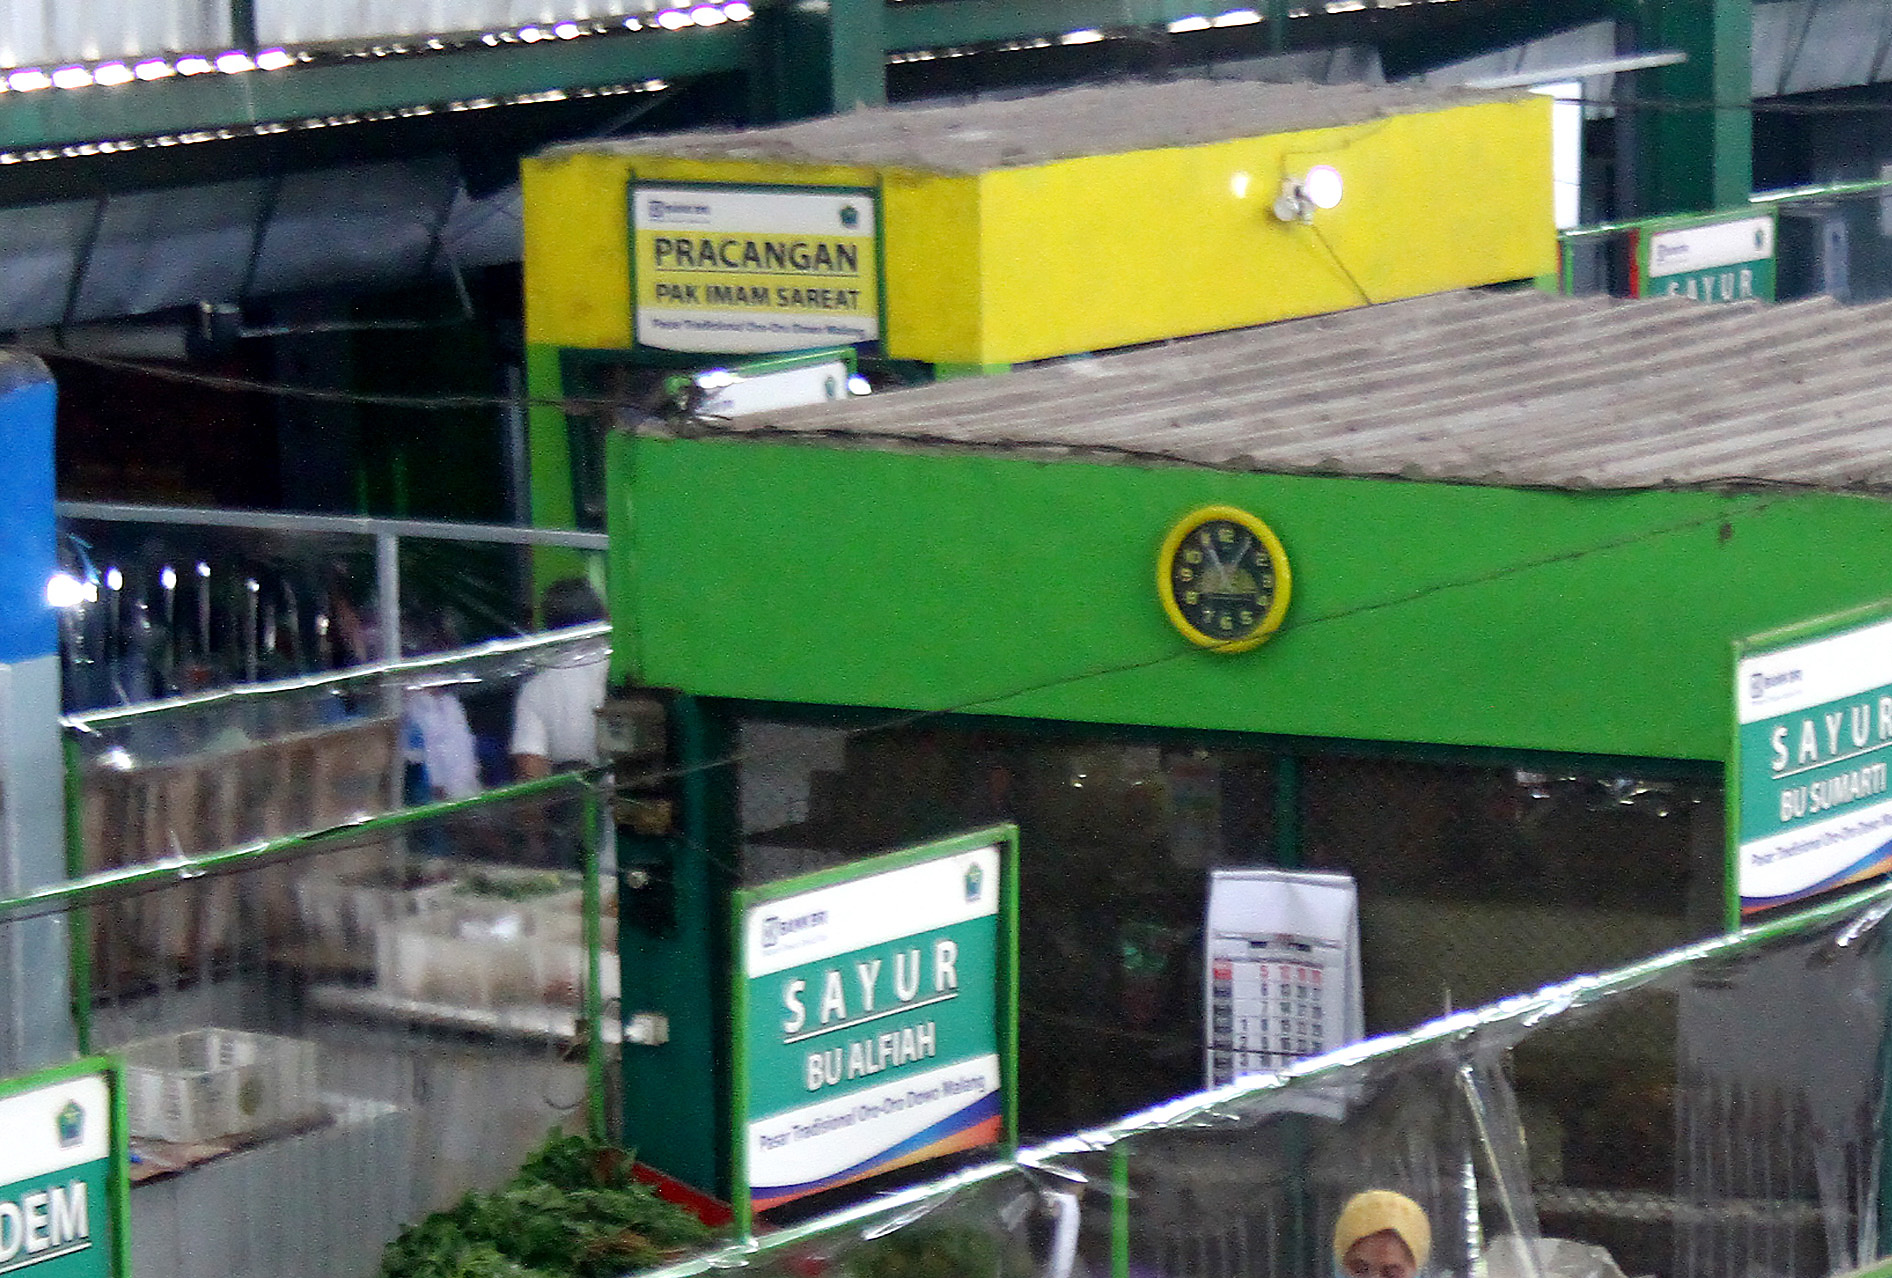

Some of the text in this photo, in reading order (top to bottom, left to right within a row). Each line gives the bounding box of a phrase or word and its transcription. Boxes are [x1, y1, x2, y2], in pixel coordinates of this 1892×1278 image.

[655, 238, 859, 272] PRACANGAN
[656, 283, 861, 310] PAK IMAM SAREAT
[1780, 762, 1888, 823] BU SUMARTI
[782, 940, 958, 1034] SAYUR
[806, 1021, 936, 1092] BU ALFIAH
